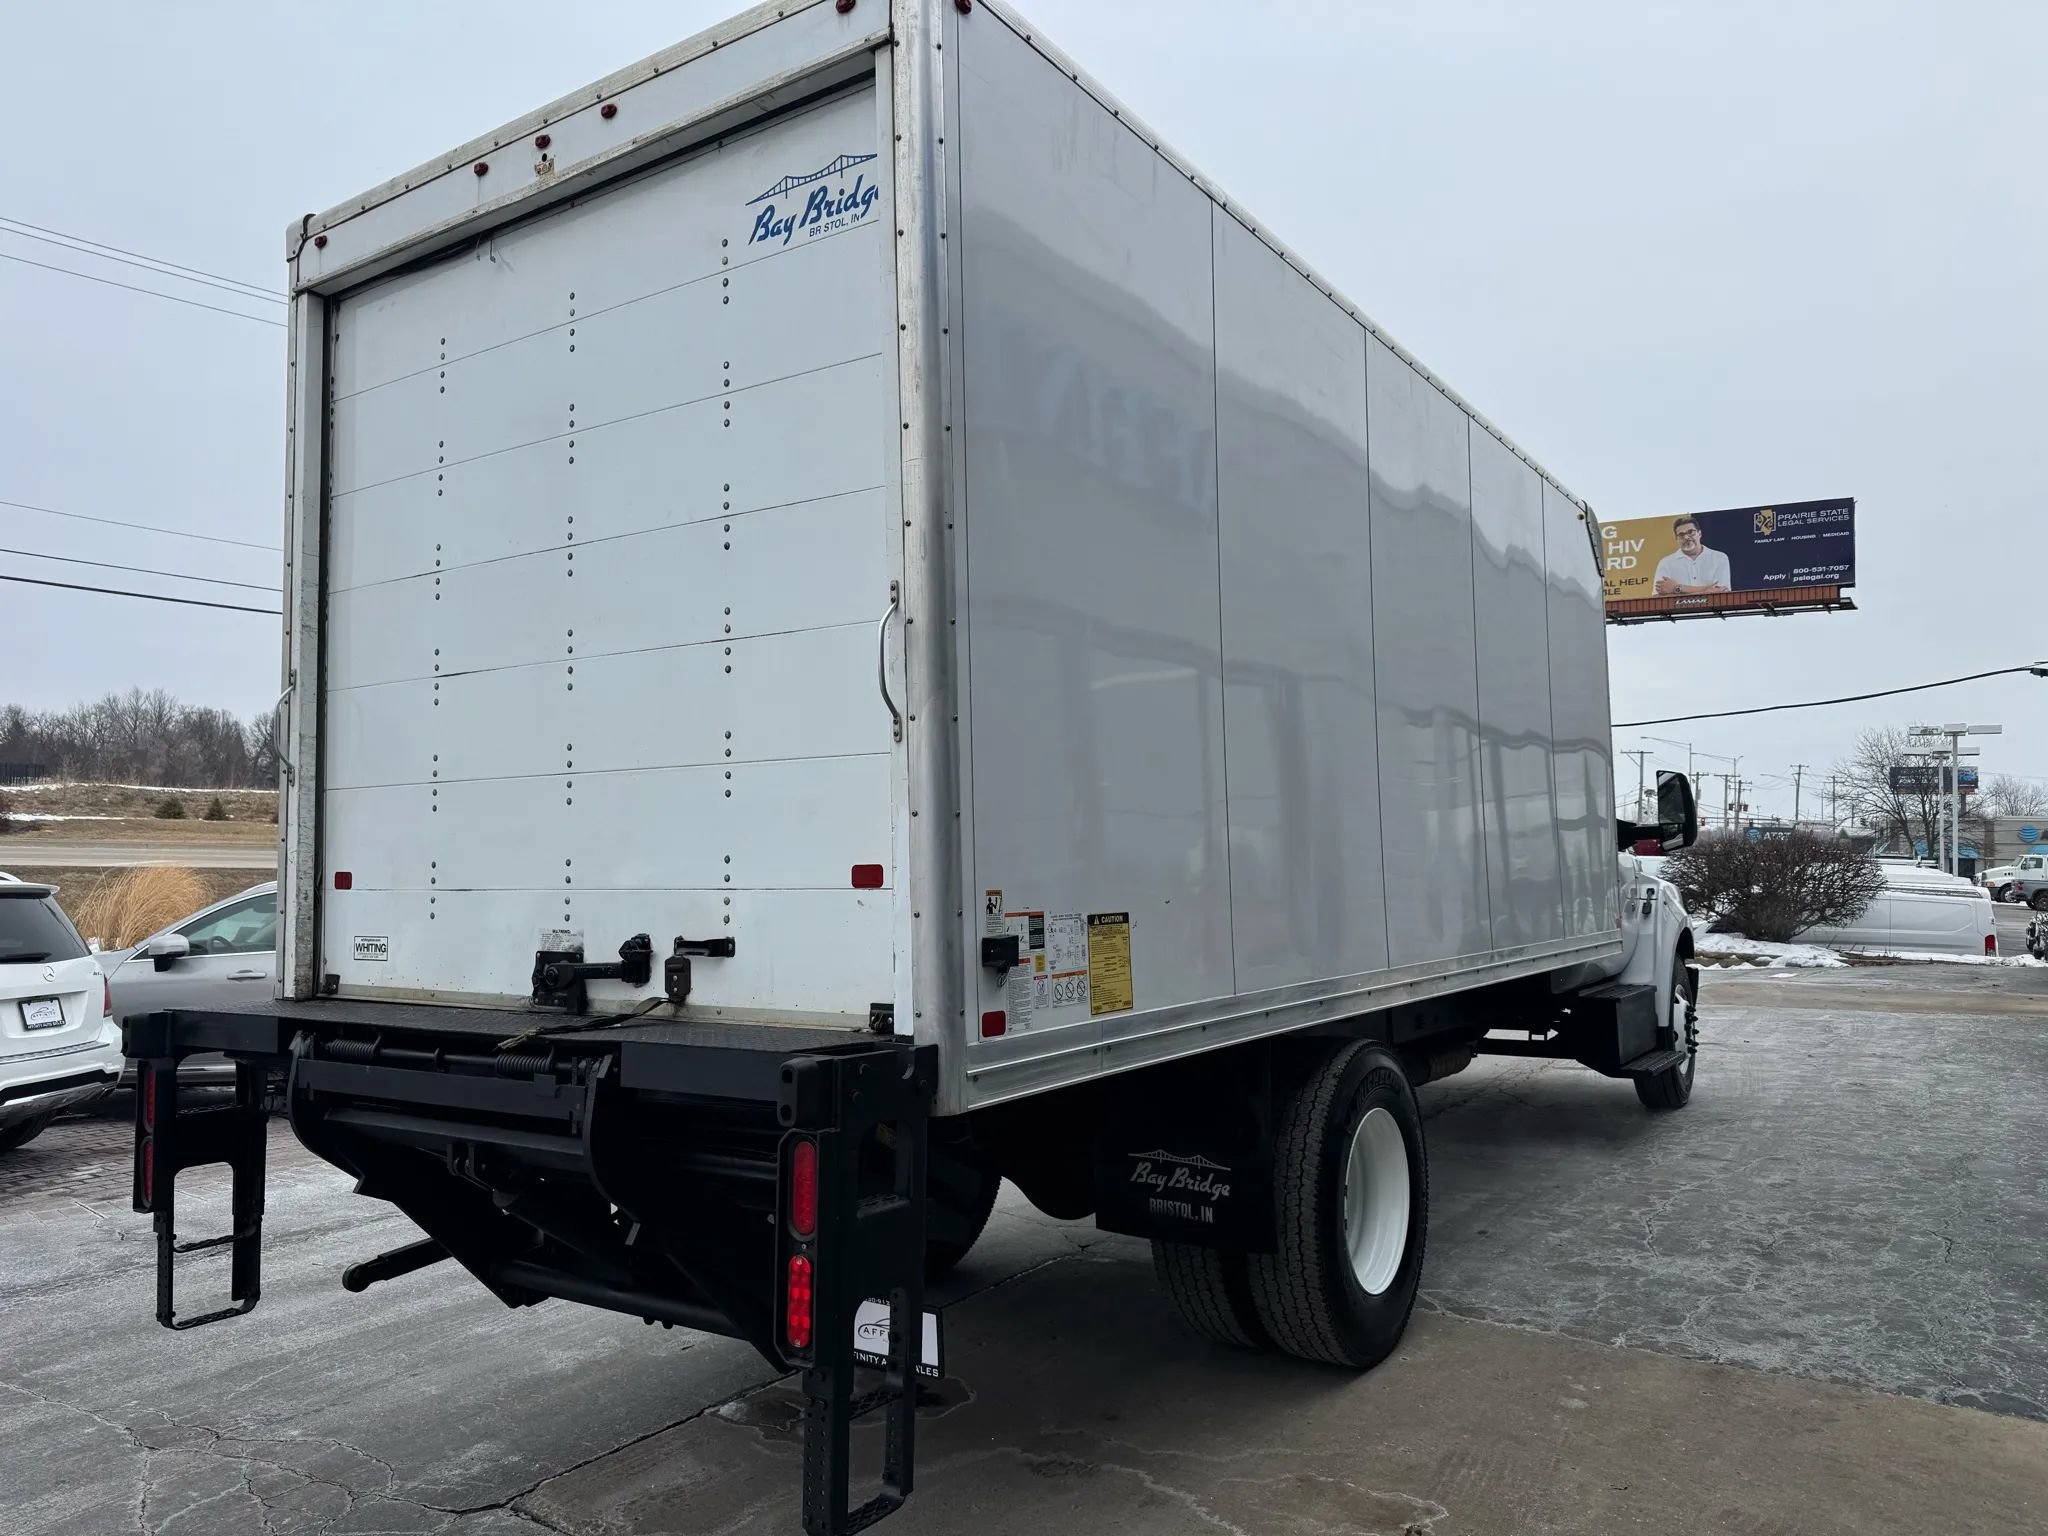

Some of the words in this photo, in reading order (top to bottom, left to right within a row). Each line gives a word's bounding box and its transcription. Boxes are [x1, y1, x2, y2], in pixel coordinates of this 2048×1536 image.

[748, 204, 797, 246] Bay
[1777, 511, 1817, 521] PRAIRIE
[1819, 507, 1849, 517] STATE
[1777, 519, 1805, 528] LEGAL
[1806, 514, 1850, 524] SERVICES
[1608, 538, 1646, 555] HIV
[1604, 556, 1637, 572] RD
[1619, 577, 1649, 587] HELP
[1763, 572, 1787, 582] Apply
[1793, 573, 1840, 583] pslegal.org
[1763, 831, 1792, 841] AT&T
[1101, 914, 1124, 924] CAUTION
[355, 942, 387, 953] WHITING
[1130, 1161, 1168, 1192] Bay
[1168, 1166, 1231, 1201] Bridge
[1201, 1205, 1214, 1224] IN
